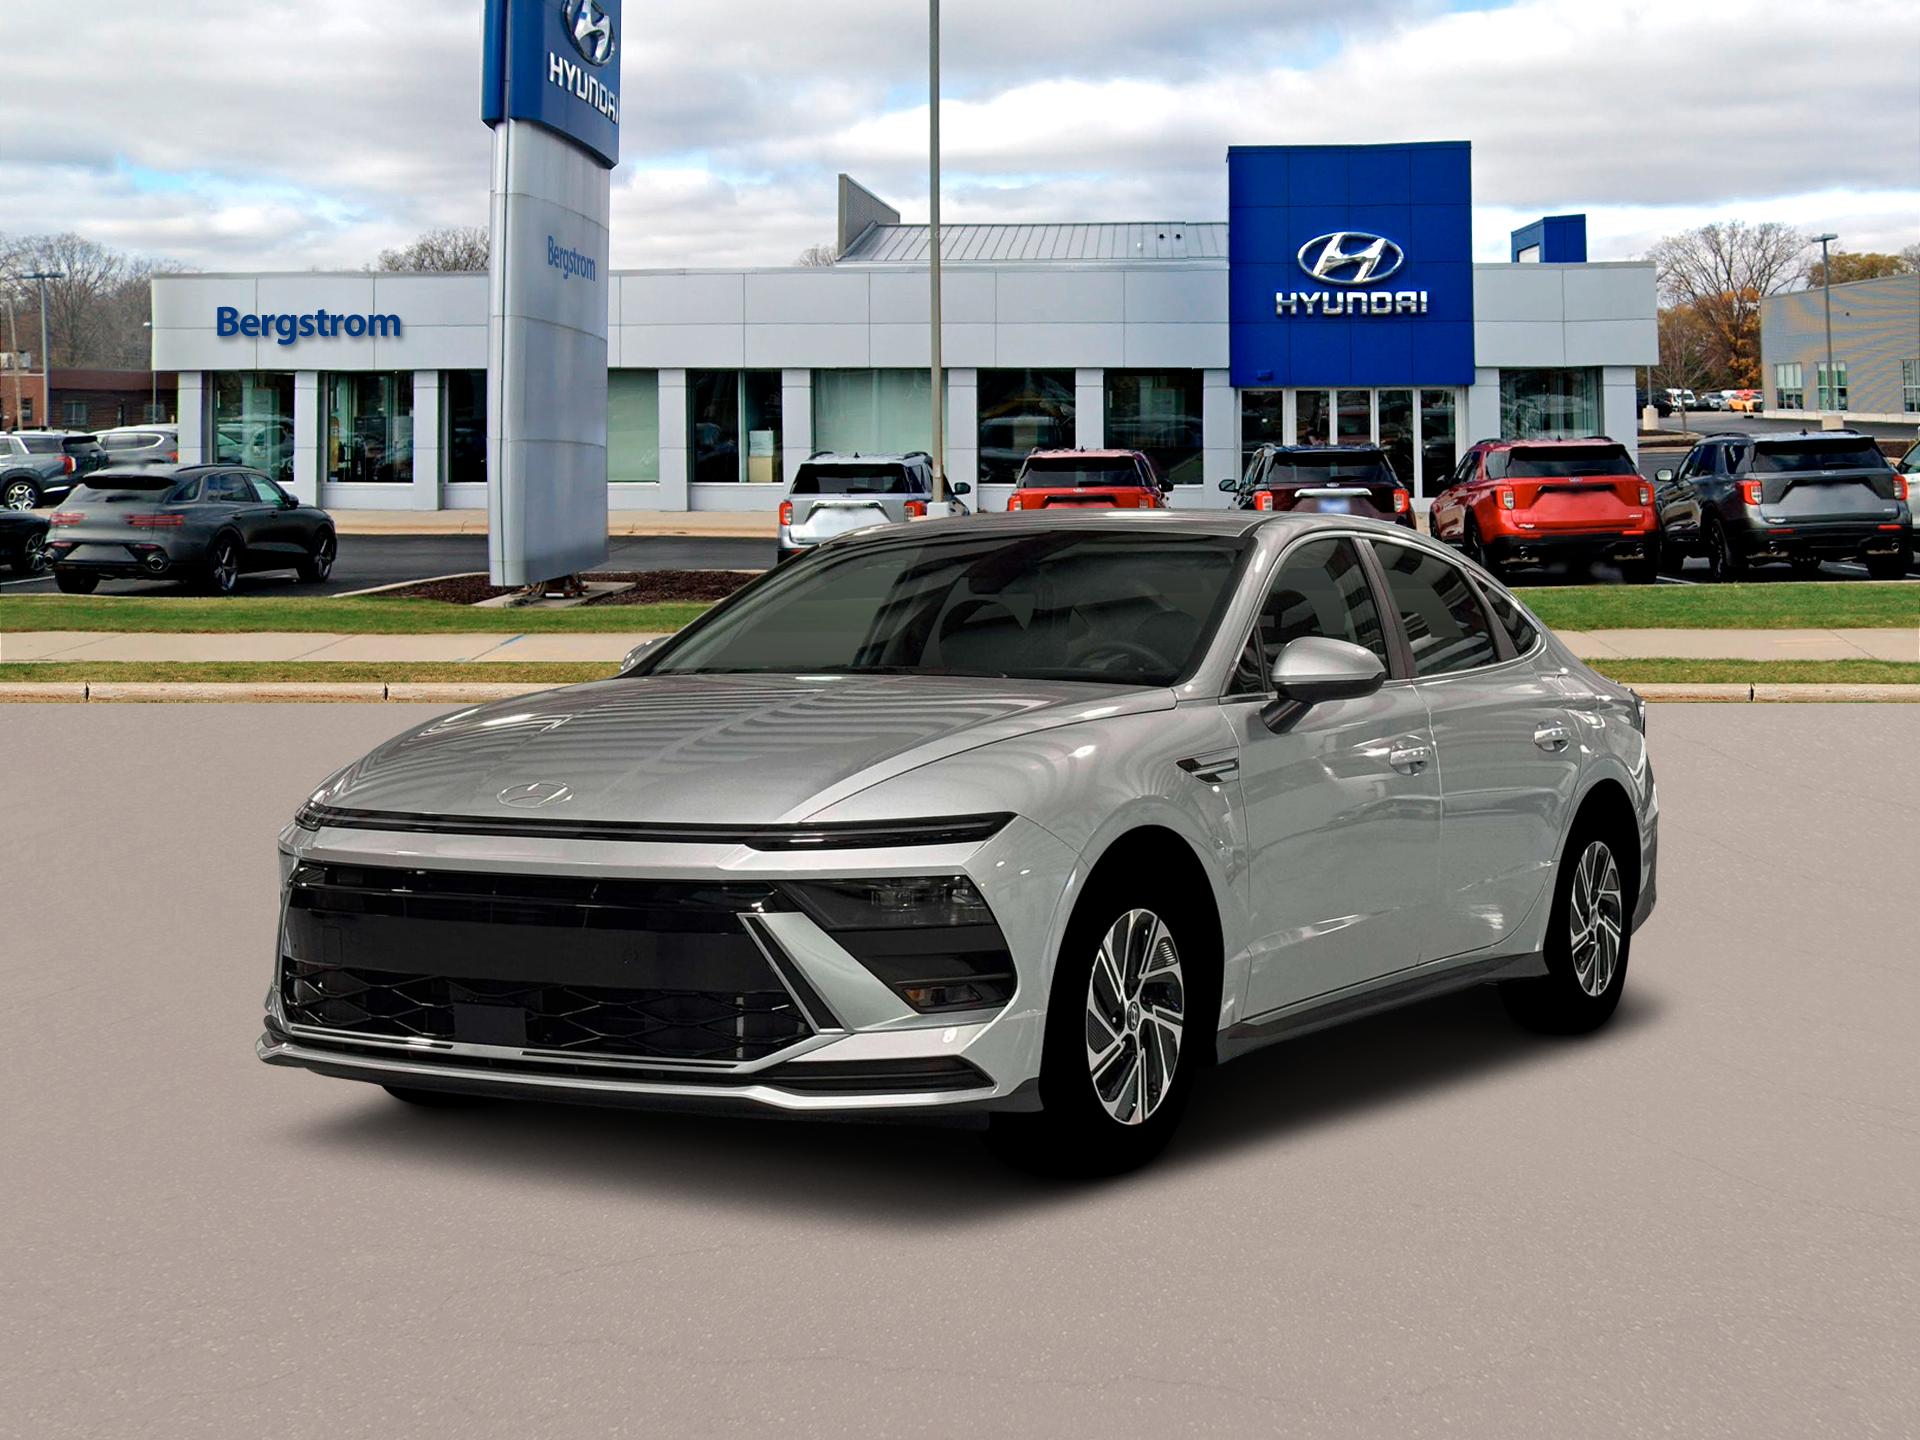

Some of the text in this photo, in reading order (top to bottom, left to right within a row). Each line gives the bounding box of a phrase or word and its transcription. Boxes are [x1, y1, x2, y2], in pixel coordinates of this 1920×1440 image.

[549, 52, 619, 123] HYUNDAI
[548, 235, 596, 281] Bergstrom
[1276, 290, 1428, 314] HYUNDAI
[217, 306, 401, 345] Bergstrom
